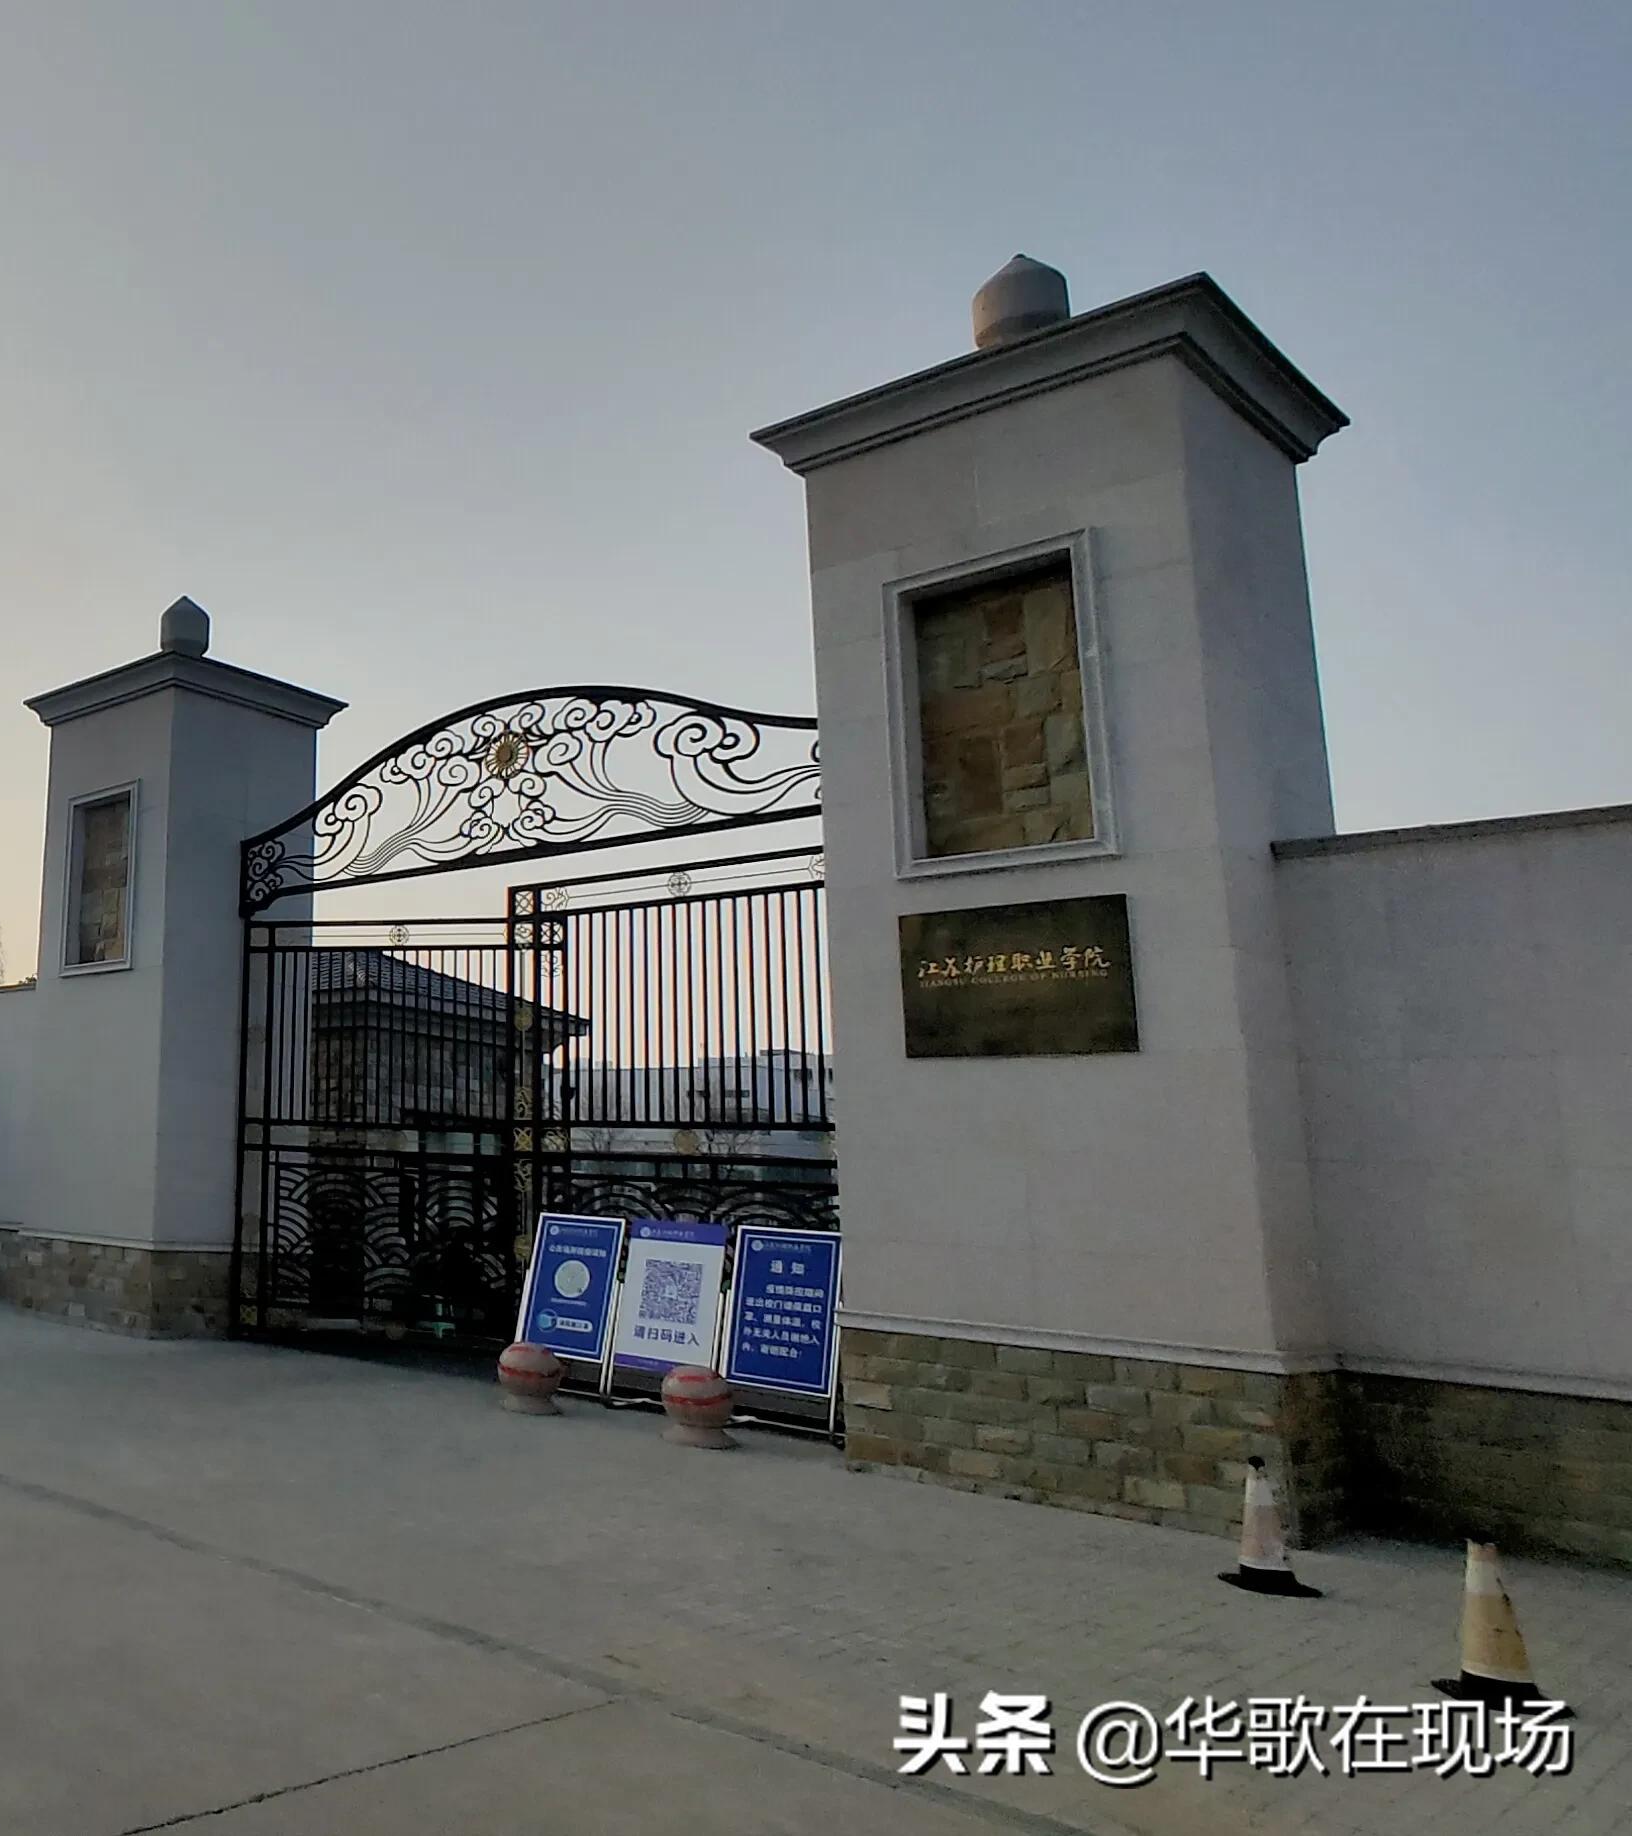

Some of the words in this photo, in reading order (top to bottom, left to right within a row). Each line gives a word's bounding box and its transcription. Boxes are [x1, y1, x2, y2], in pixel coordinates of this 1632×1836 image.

[917, 945, 1111, 978] 江苏护理职业学院
[971, 973, 1026, 985] COLLEGE
[1030, 973, 1046, 982] OF
[1051, 969, 1108, 980] NURSING
[634, 1325, 700, 1346] 请扫码进入
